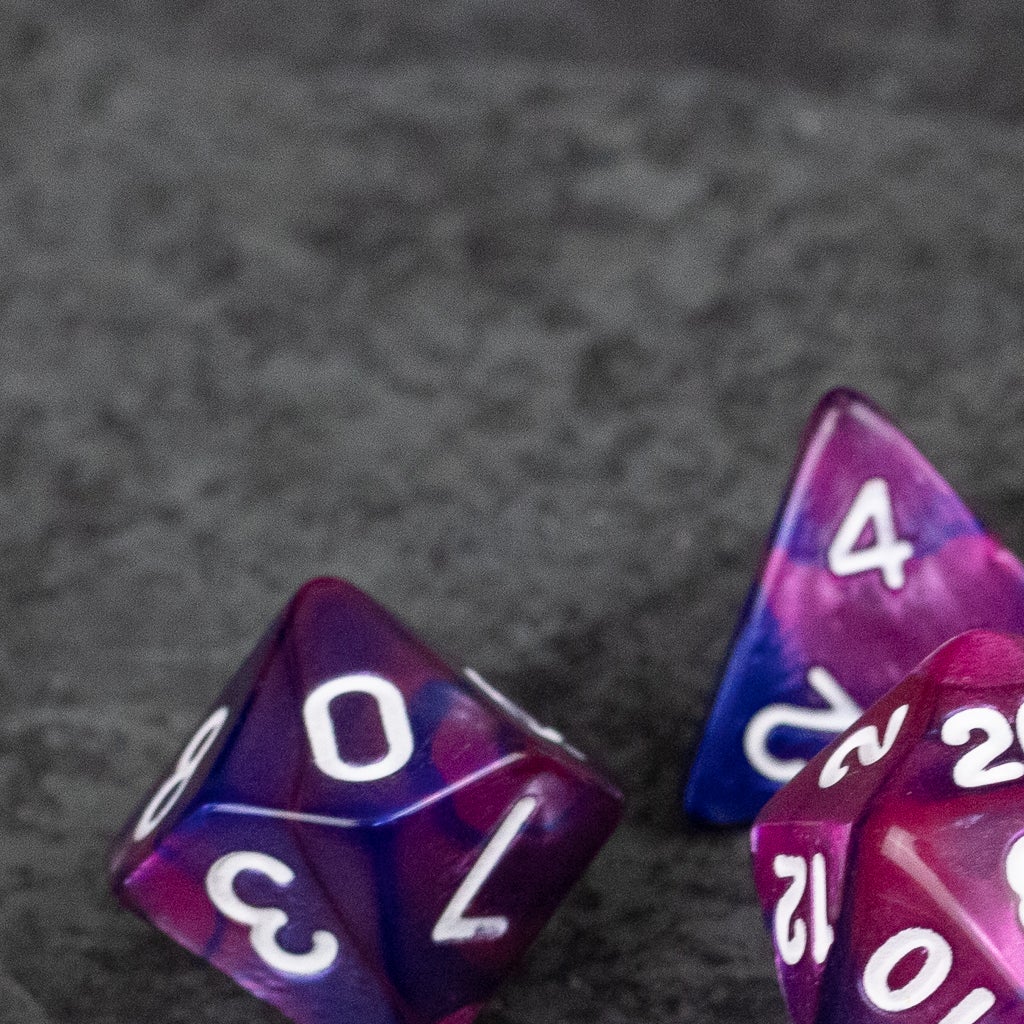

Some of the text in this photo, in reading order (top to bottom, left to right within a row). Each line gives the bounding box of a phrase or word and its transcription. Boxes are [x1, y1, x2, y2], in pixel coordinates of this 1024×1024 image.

[828, 478, 914, 590] 4
[133, 706, 229, 841] 8
[302, 673, 415, 783] 0
[744, 667, 864, 782] 2
[818, 704, 909, 789] 2
[205, 851, 339, 977] 3
[431, 795, 538, 943] 7
[772, 853, 834, 965] 12
